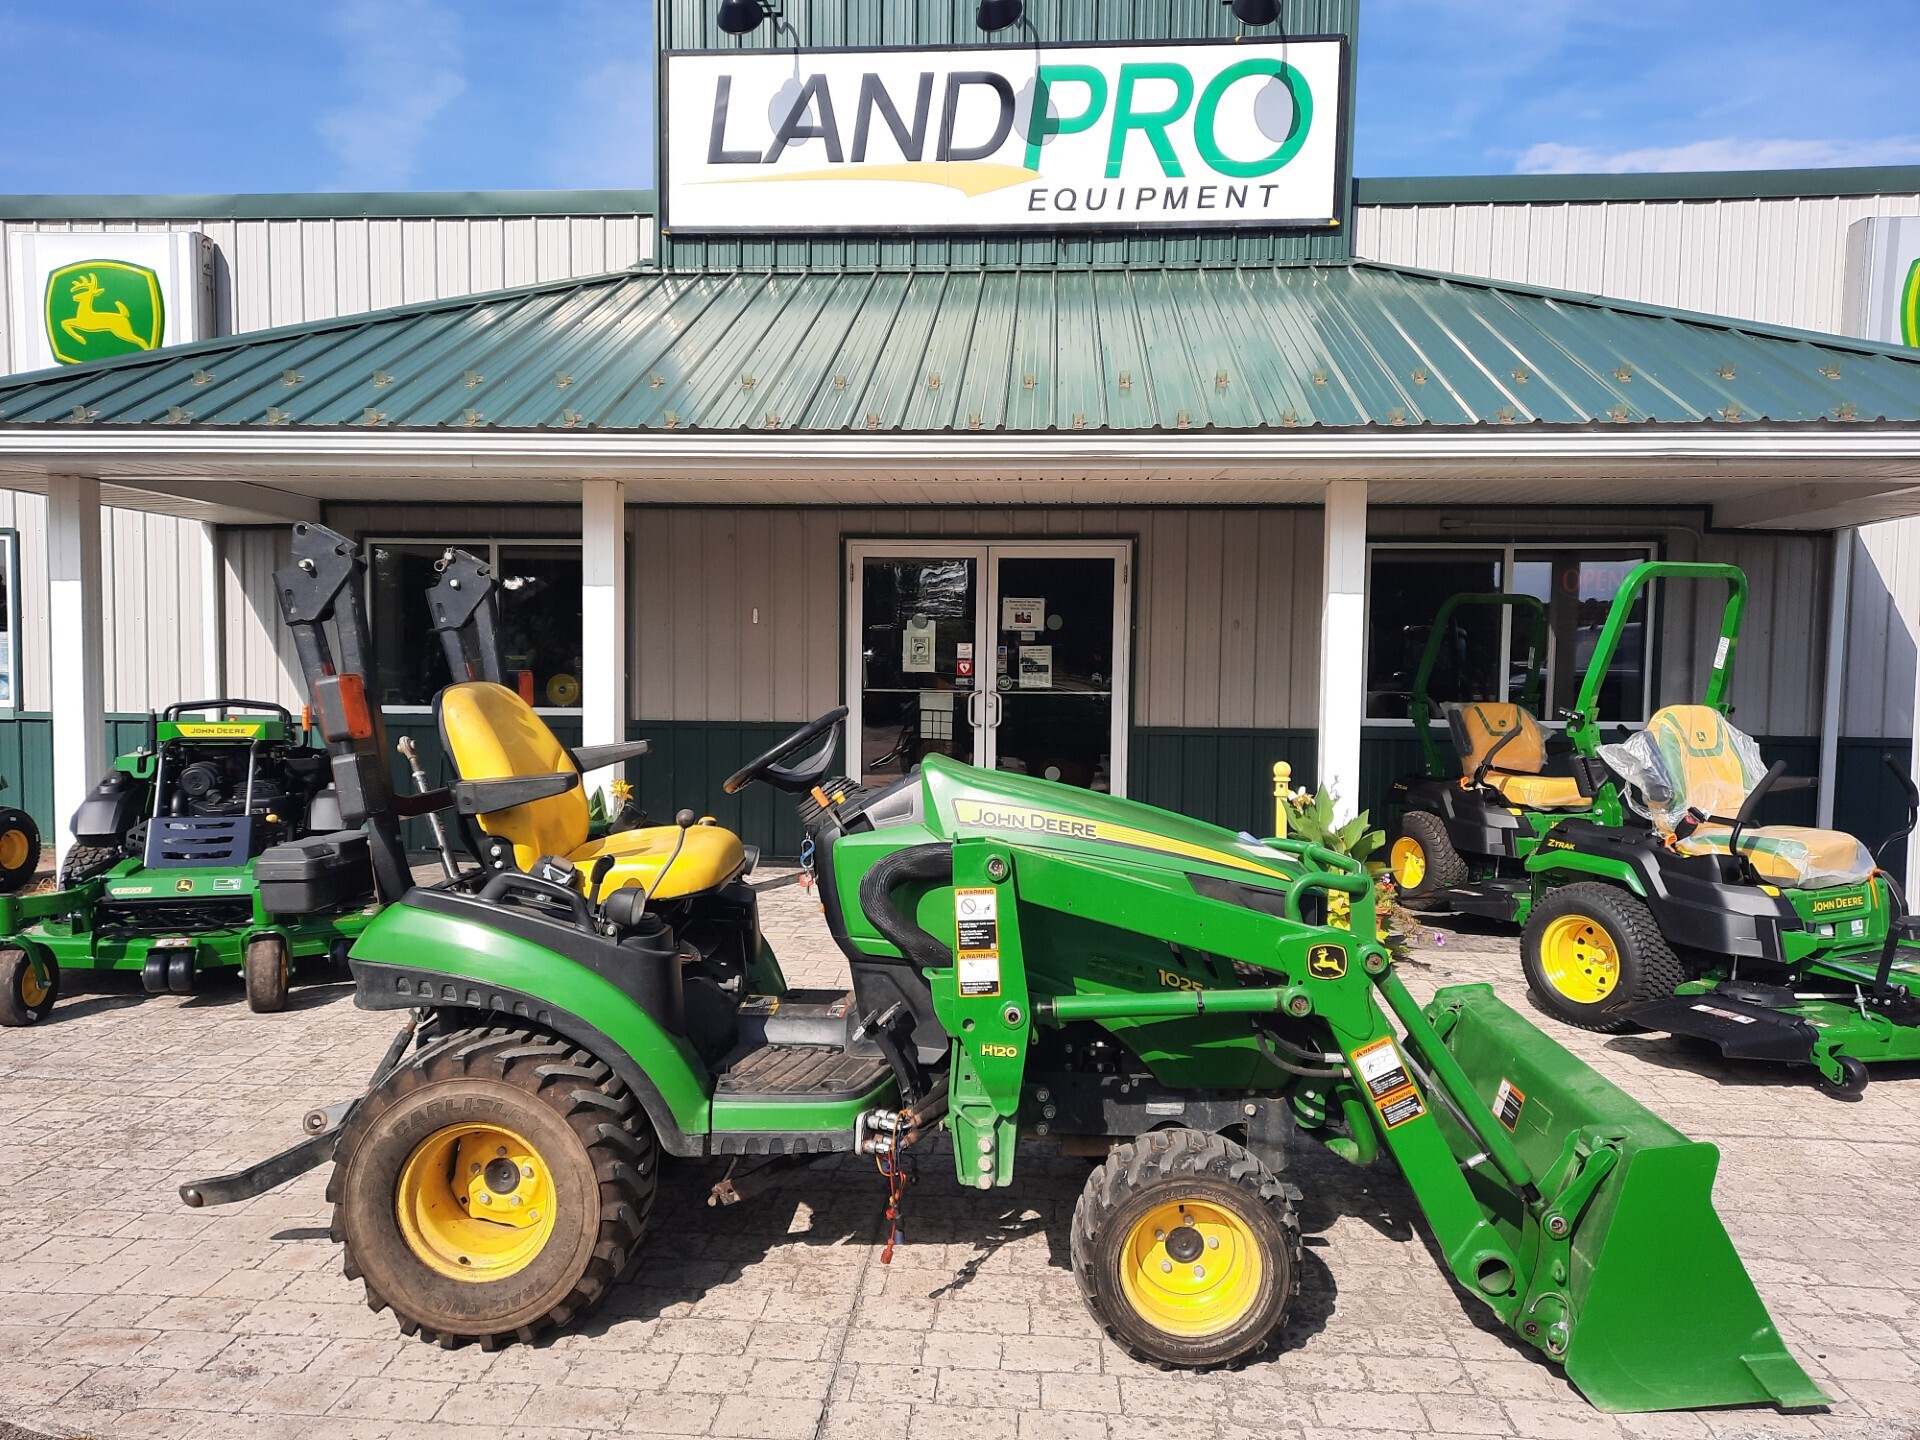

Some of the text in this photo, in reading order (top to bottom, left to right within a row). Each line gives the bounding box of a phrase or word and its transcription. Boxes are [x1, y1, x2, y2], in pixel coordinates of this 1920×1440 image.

[1028, 184, 1279, 211] EQUIPMENT
[1562, 568, 1625, 592] OPEN
[972, 808, 1097, 838] JOHN DEERE
[1547, 838, 1576, 850] ZTRAK
[1812, 896, 1864, 912] JOHN DEERE
[1159, 969, 1216, 990] 1025
[981, 1044, 1018, 1058] H120
[1362, 1041, 1388, 1055] WARNING
[1387, 1090, 1412, 1104] WARNING
[392, 1098, 529, 1139] CARLISLE
